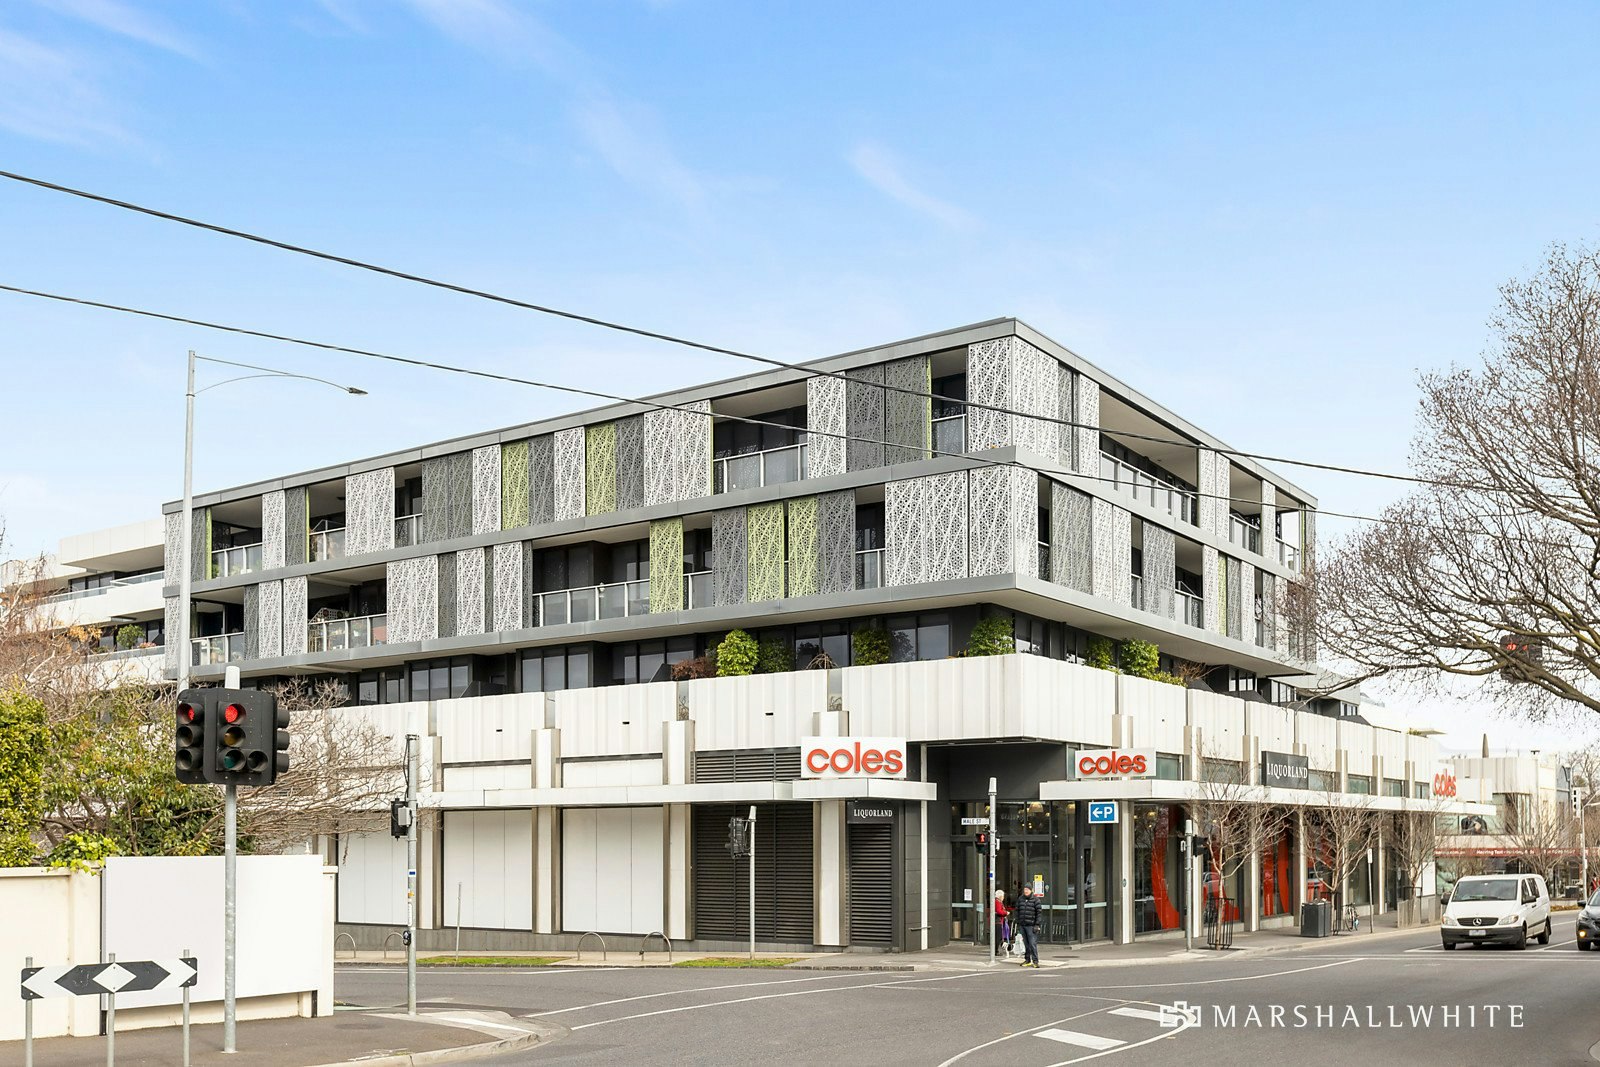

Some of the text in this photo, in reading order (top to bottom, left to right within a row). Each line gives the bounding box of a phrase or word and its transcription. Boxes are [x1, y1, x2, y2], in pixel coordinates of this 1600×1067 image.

[807, 742, 903, 774] coles
[1079, 751, 1147, 775] coles
[1267, 763, 1308, 779] LIQUORLAND
[1433, 768, 1456, 797] coles
[853, 808, 893, 819] LIQUORLAND
[1103, 806, 1113, 819] P
